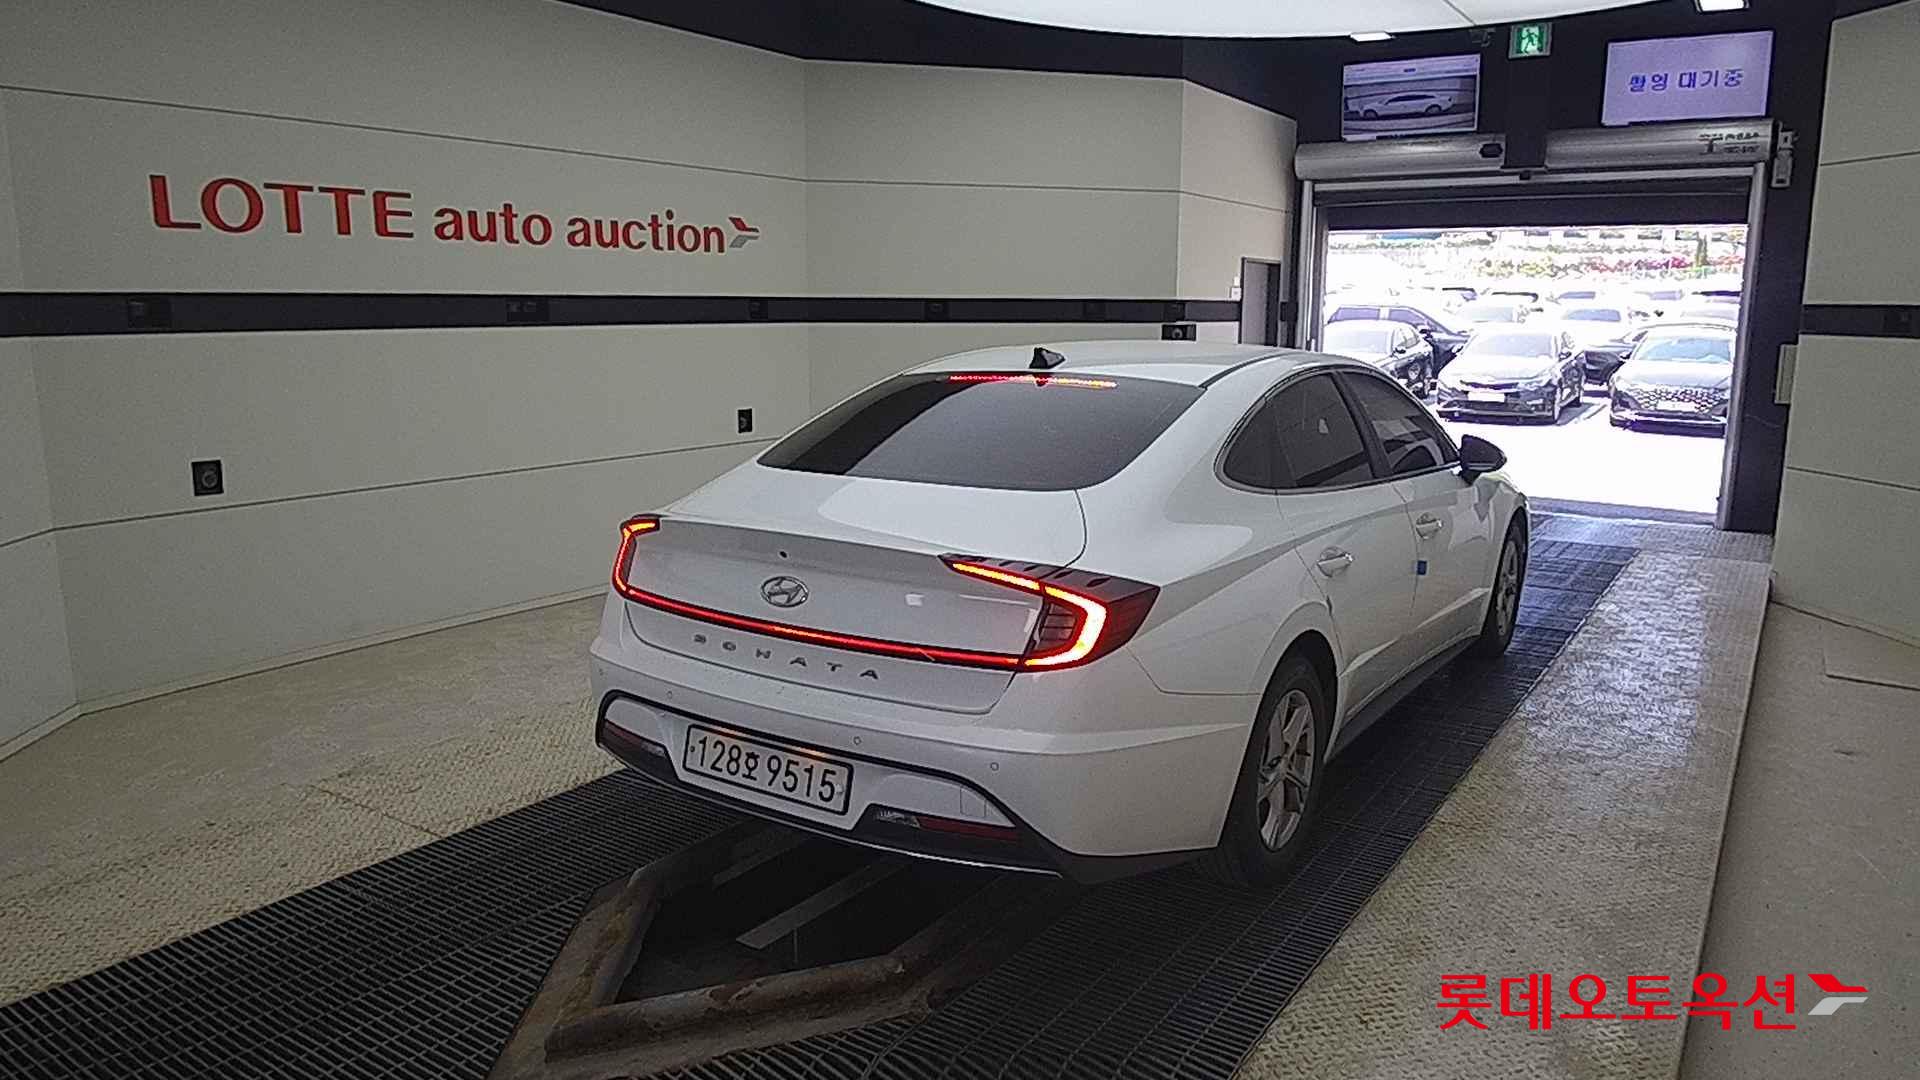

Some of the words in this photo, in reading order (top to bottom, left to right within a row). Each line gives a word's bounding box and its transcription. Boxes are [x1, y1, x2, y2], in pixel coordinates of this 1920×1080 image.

[1678, 68, 1743, 89] 대기중
[149, 174, 415, 240] LOTTE
[433, 203, 553, 247] auto
[567, 208, 726, 254] auction
[693, 633, 880, 681] SONATA
[698, 735, 760, 782] 128호
[766, 754, 838, 803] 9515
